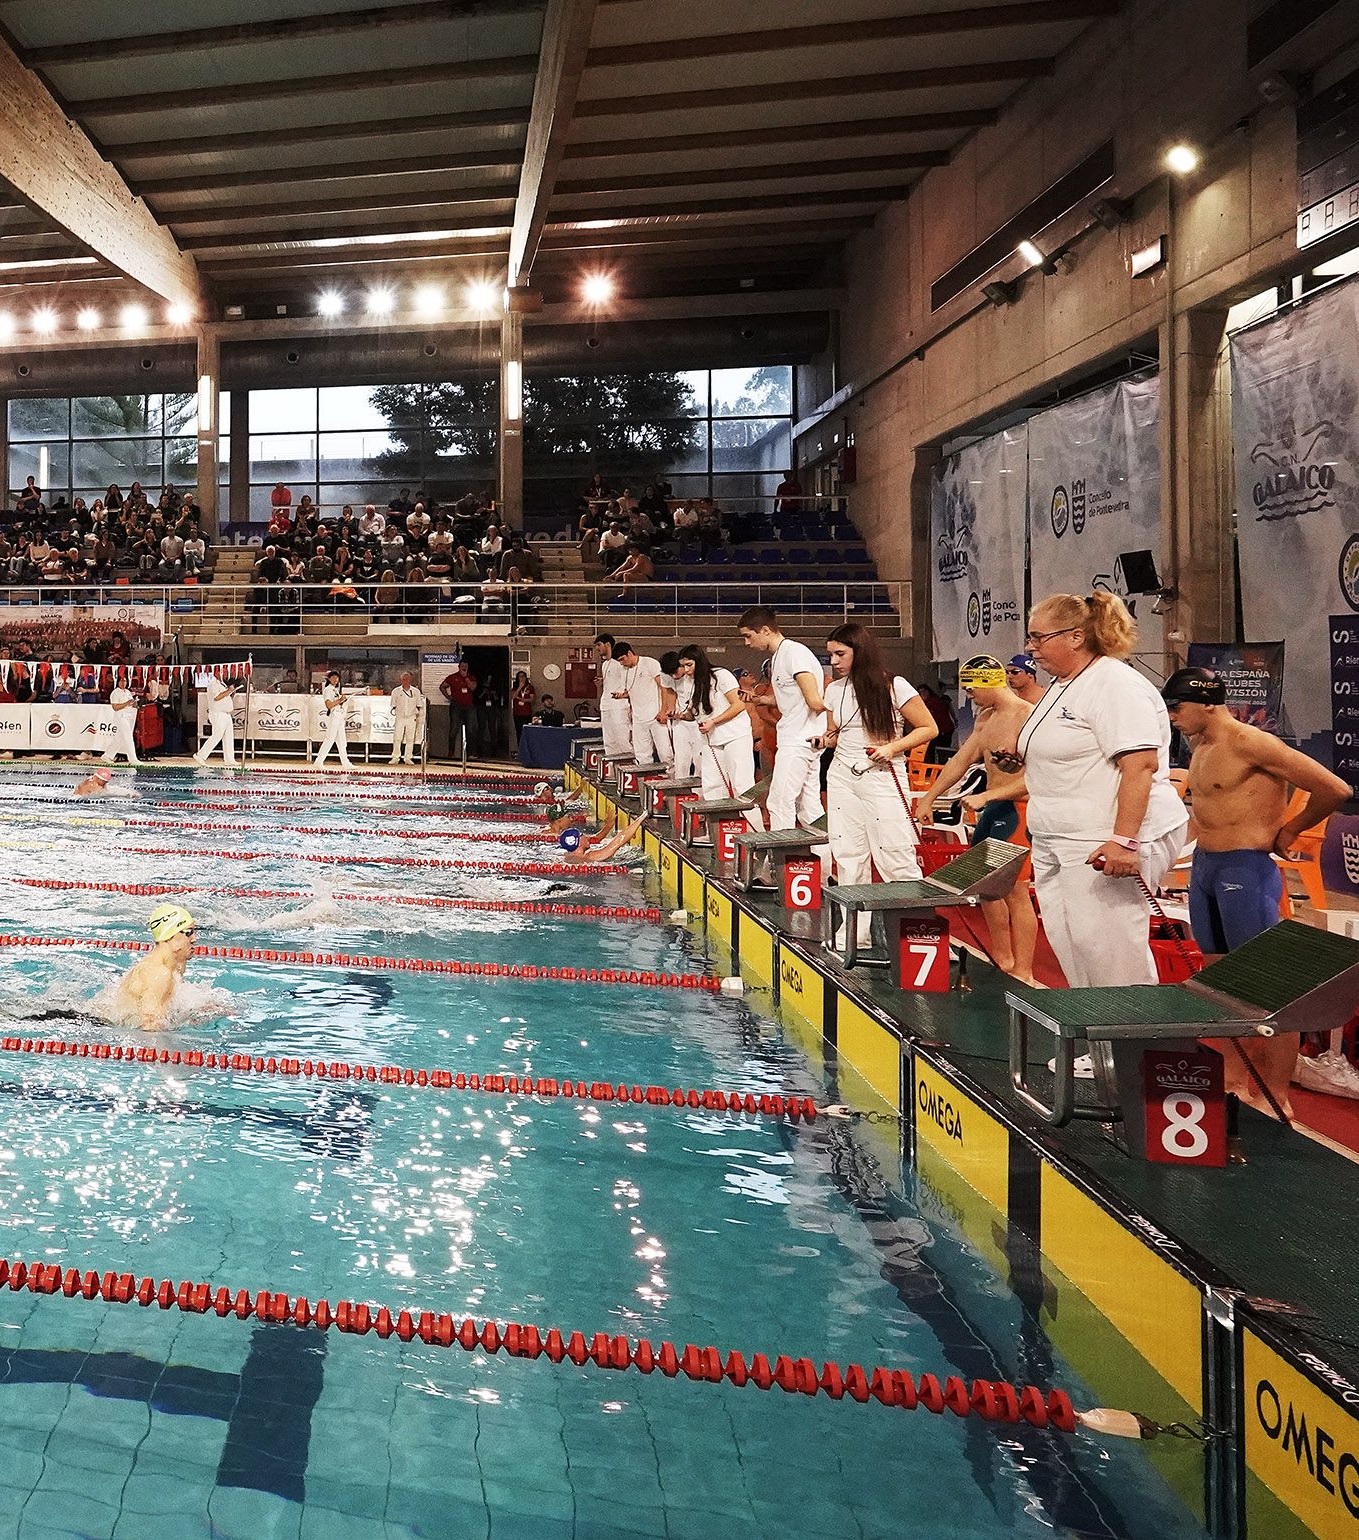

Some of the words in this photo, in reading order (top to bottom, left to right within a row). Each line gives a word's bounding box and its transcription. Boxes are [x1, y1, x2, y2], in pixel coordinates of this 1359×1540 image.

[1229, 669, 1270, 678] ESPAÑA
[1226, 688, 1267, 697] VISIÓN
[99, 722, 118, 733] Rfe
[258, 719, 301, 728] GALAICO
[624, 773, 634, 789] 2
[724, 834, 735, 859] 5
[790, 874, 812, 907] 6
[909, 944, 938, 987] 7
[780, 959, 804, 999] OMEGA
[1155, 1074, 1211, 1087] GALAICO
[918, 1080, 964, 1148] OMEGA
[1161, 1091, 1209, 1158] 8
[1255, 1379, 1359, 1521] OMEG
